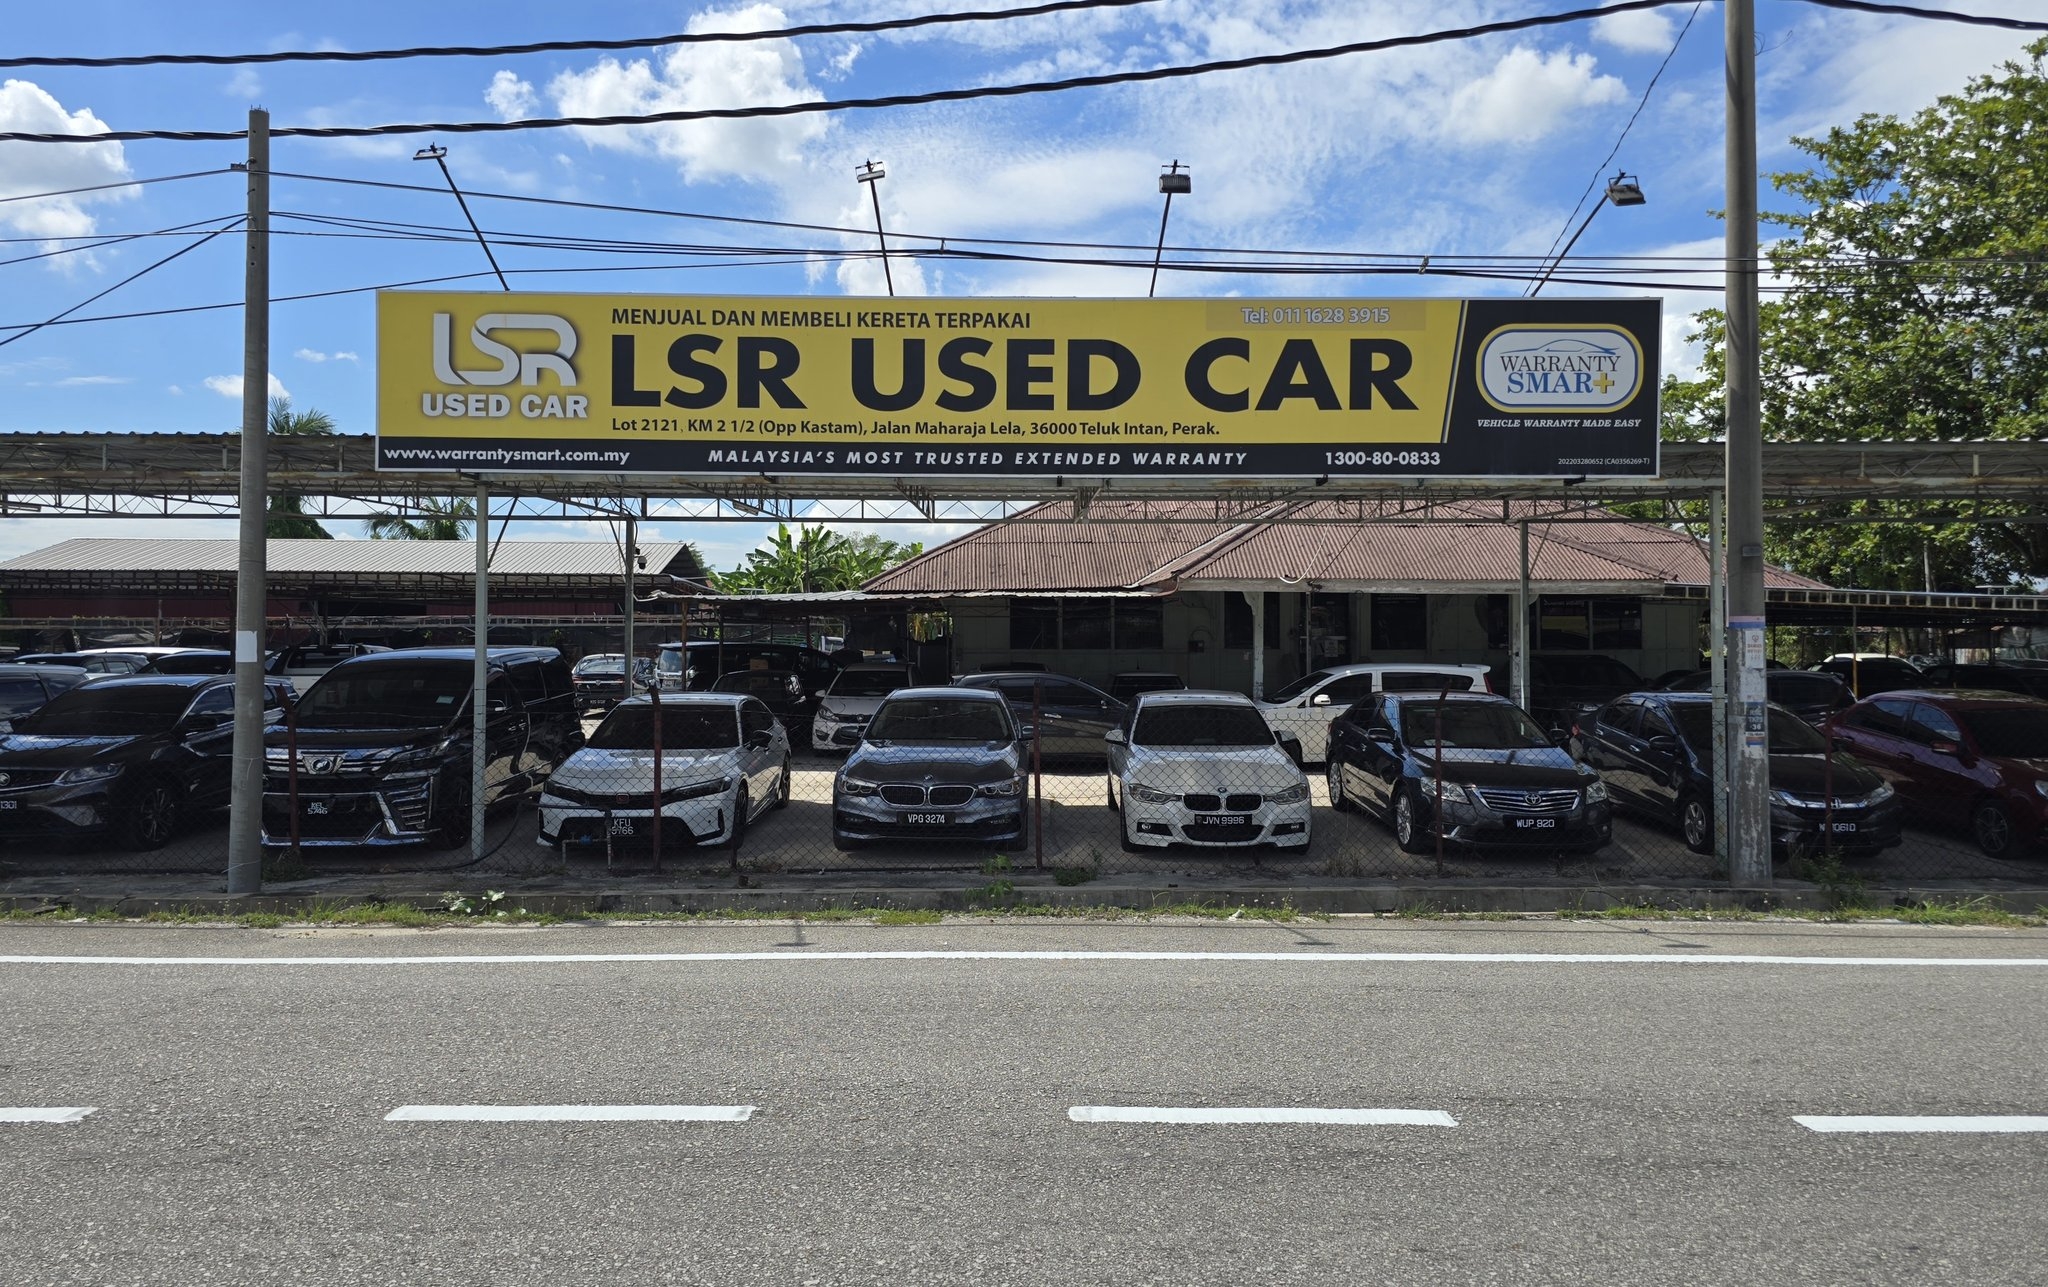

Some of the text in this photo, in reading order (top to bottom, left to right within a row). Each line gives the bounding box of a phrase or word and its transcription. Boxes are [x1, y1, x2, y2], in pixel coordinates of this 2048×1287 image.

[612, 309, 1030, 329] MENJUAL DAN MEMBELI KERETA TERPAKAI
[1241, 307, 1390, 324] Tel: 011 1628 3915
[433, 312, 580, 387] LSR
[1500, 355, 1621, 372] WARRANTY
[612, 334, 1420, 412] LSR USED CAR
[422, 394, 588, 419] USED CAR
[612, 418, 637, 431] Lot
[688, 419, 713, 432] KM
[717, 420, 726, 432] 2
[731, 420, 755, 433] 1/2
[759, 420, 797, 436] (Opp
[801, 421, 867, 436] Kastam),
[871, 421, 910, 434] Jalan
[915, 422, 986, 438] Maharaja
[992, 422, 1025, 437] Lela,
[1031, 422, 1078, 435] 36000
[1080, 422, 1120, 435] Teluk
[1124, 422, 1168, 437] Intan,
[1172, 422, 1220, 435] Perak.
[1477, 419, 1641, 427] VEHICLE WARRANTY MADE EASY
[384, 449, 630, 465] www.warrantysmart.com.my
[708, 450, 1247, 465] MALAYSIA'S MOST TRUSTED EXTENDED WARRANTY
[1325, 452, 1440, 466] 1300-80-0833
[613, 818, 631, 828] KFU
[907, 813, 946, 824] VPG 3274
[1202, 816, 1220, 825] JVN
[1516, 819, 1535, 828] WUP
